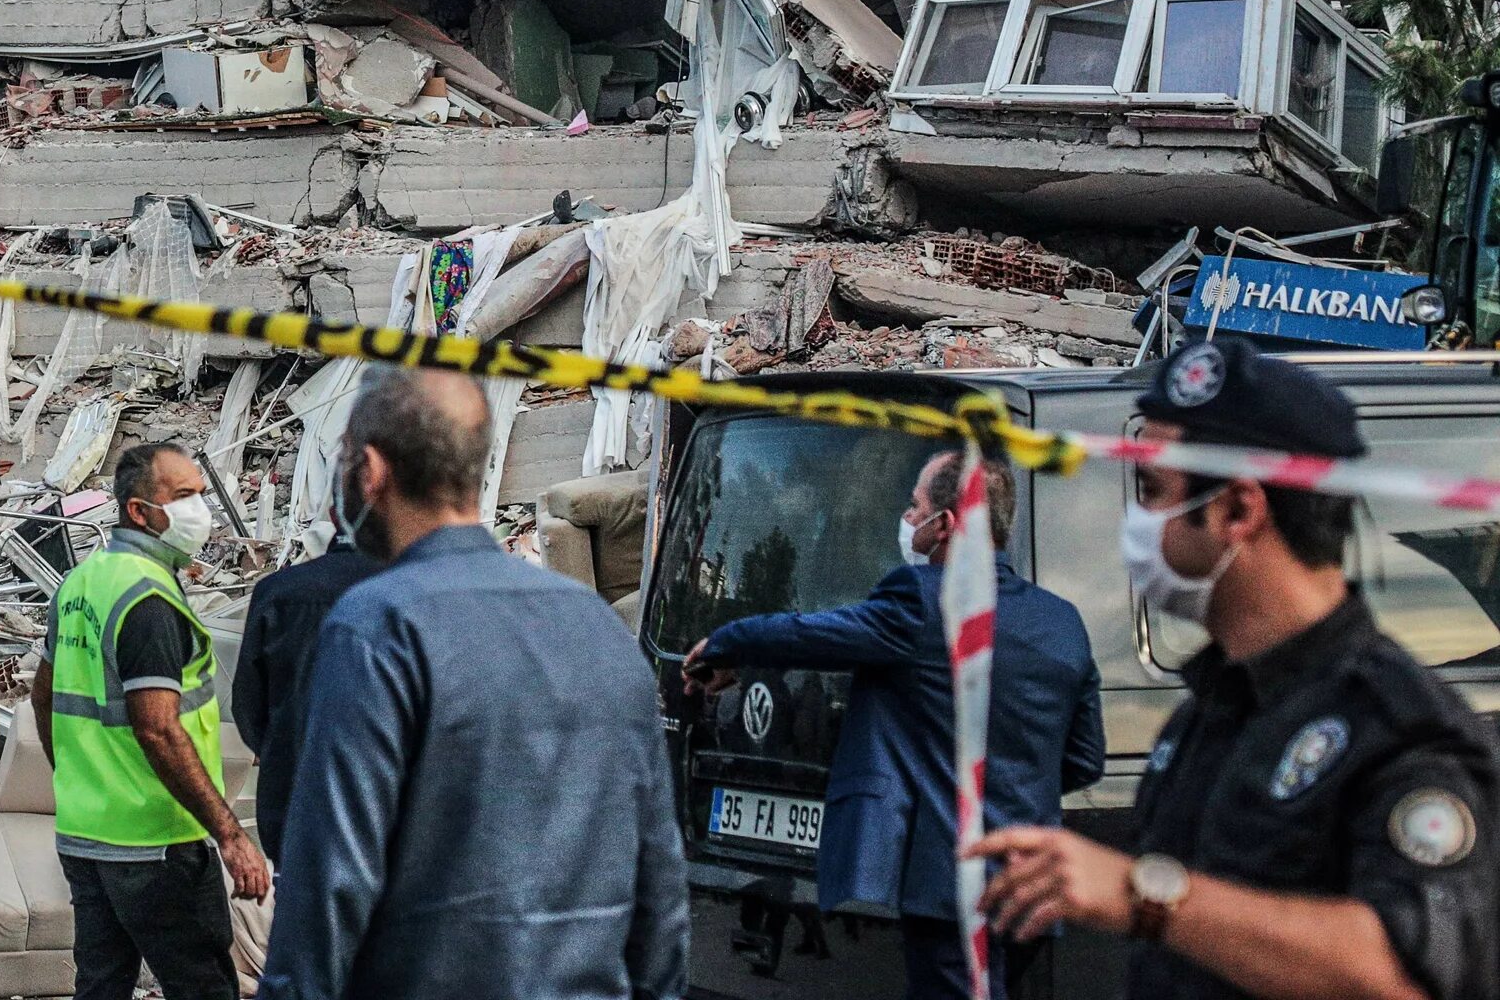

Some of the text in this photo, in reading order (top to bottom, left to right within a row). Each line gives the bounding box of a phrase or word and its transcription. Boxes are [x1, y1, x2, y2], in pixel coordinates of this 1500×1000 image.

[1242, 282, 1418, 326] HALKBAN
[722, 795, 821, 843] 35 FA 999
